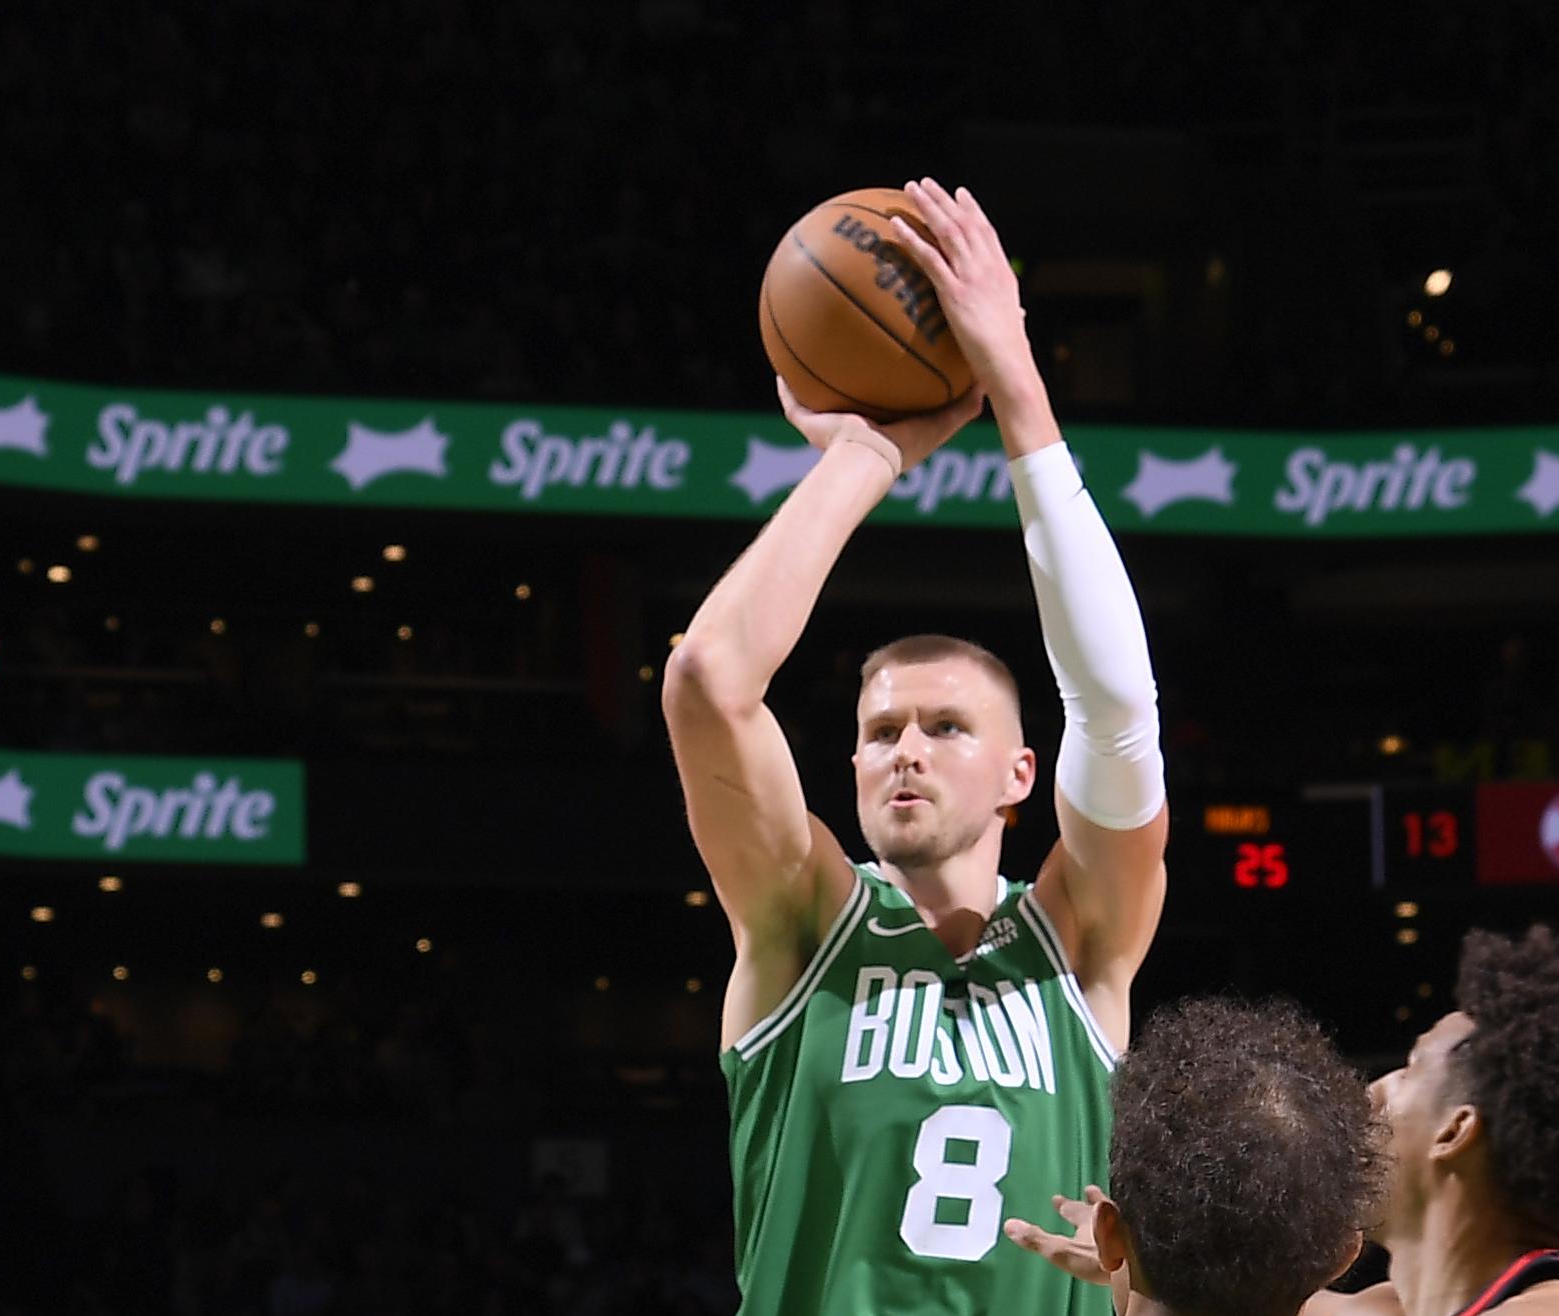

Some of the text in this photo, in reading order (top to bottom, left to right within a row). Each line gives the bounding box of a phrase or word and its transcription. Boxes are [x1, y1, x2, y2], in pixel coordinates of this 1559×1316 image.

[86, 402, 290, 485] Sprite
[488, 418, 691, 500] Sprite
[1274, 443, 1477, 527] Sprite
[71, 770, 275, 851] Sprite
[1402, 808, 1461, 860] 13
[1233, 840, 1290, 890] 25
[899, 1104, 1013, 1262] 8
